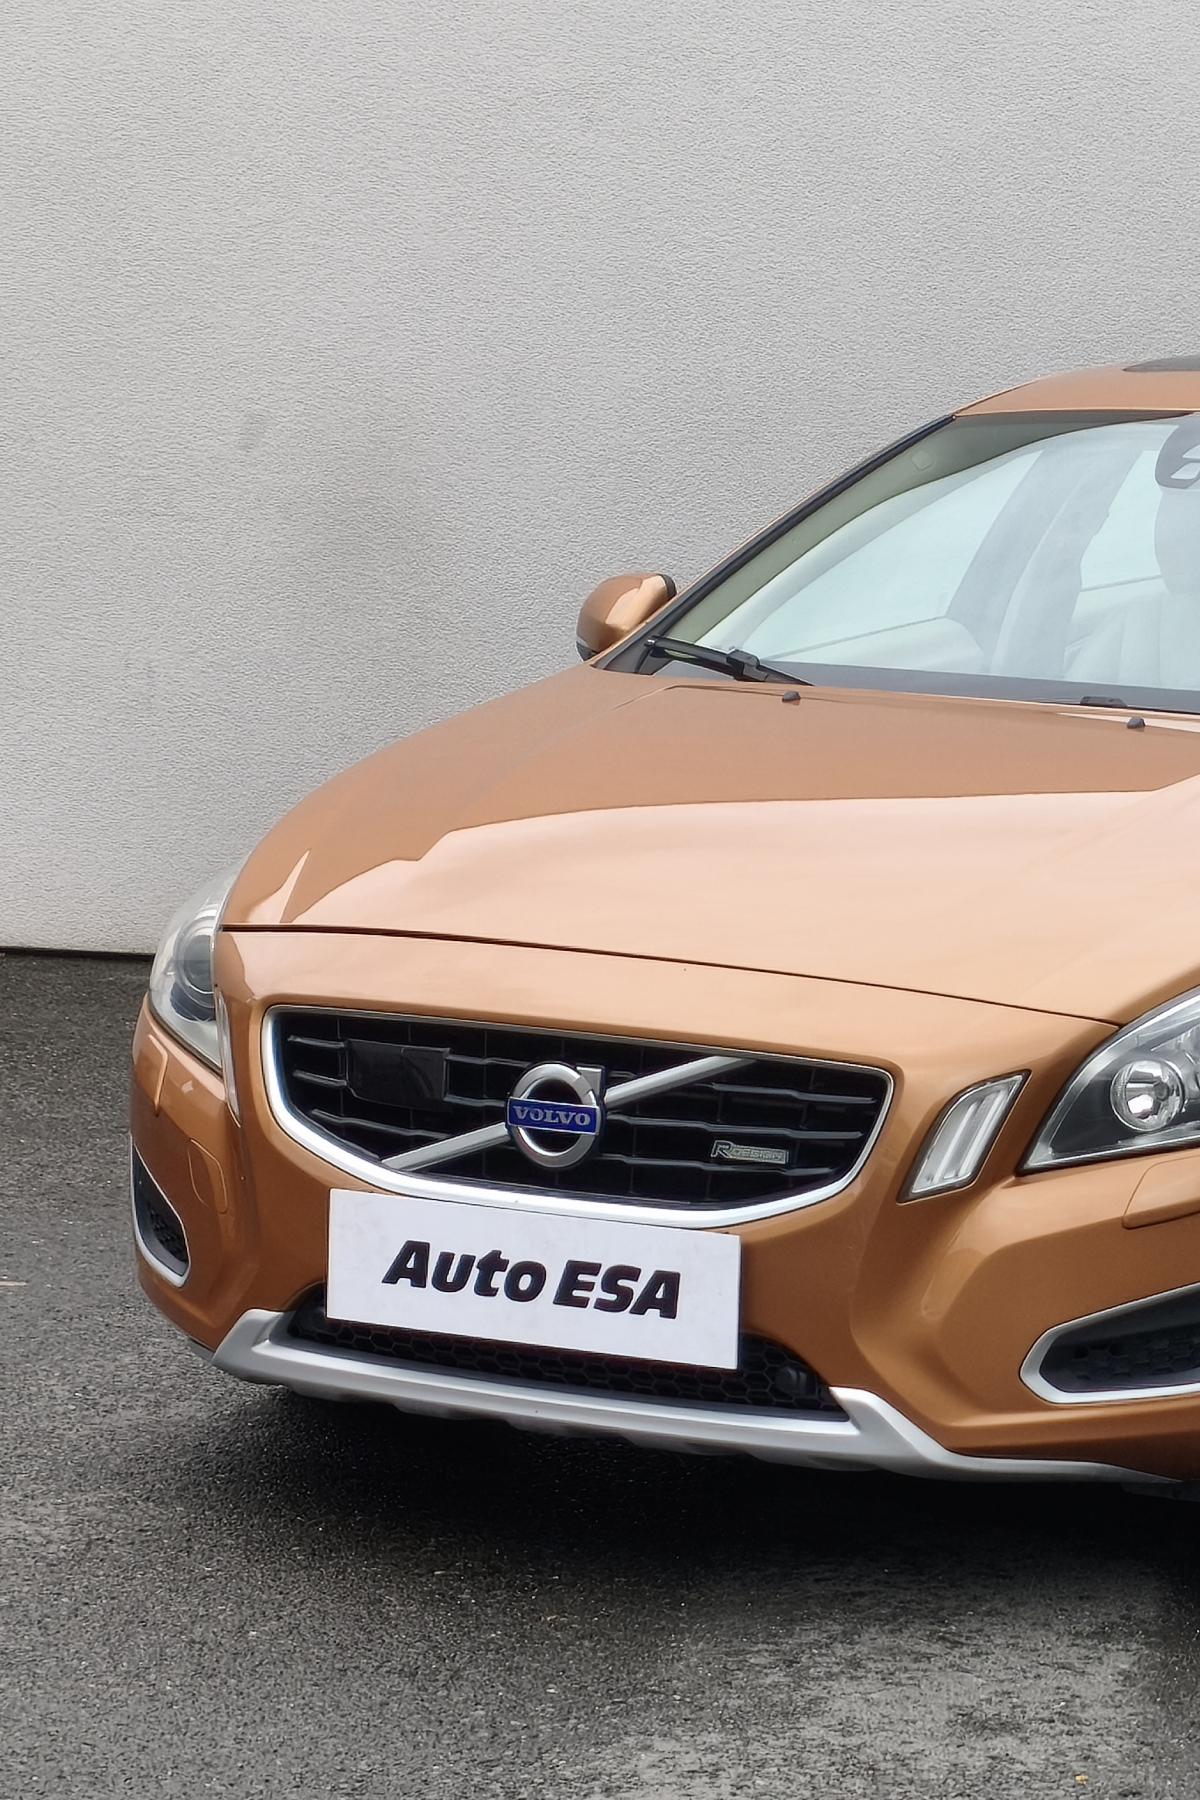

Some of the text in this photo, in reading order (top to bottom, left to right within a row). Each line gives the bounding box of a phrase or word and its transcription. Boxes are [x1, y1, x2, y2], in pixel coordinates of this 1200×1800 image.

[512, 1105, 591, 1126] VOLVO
[381, 1239, 681, 1320] Auto ESA
